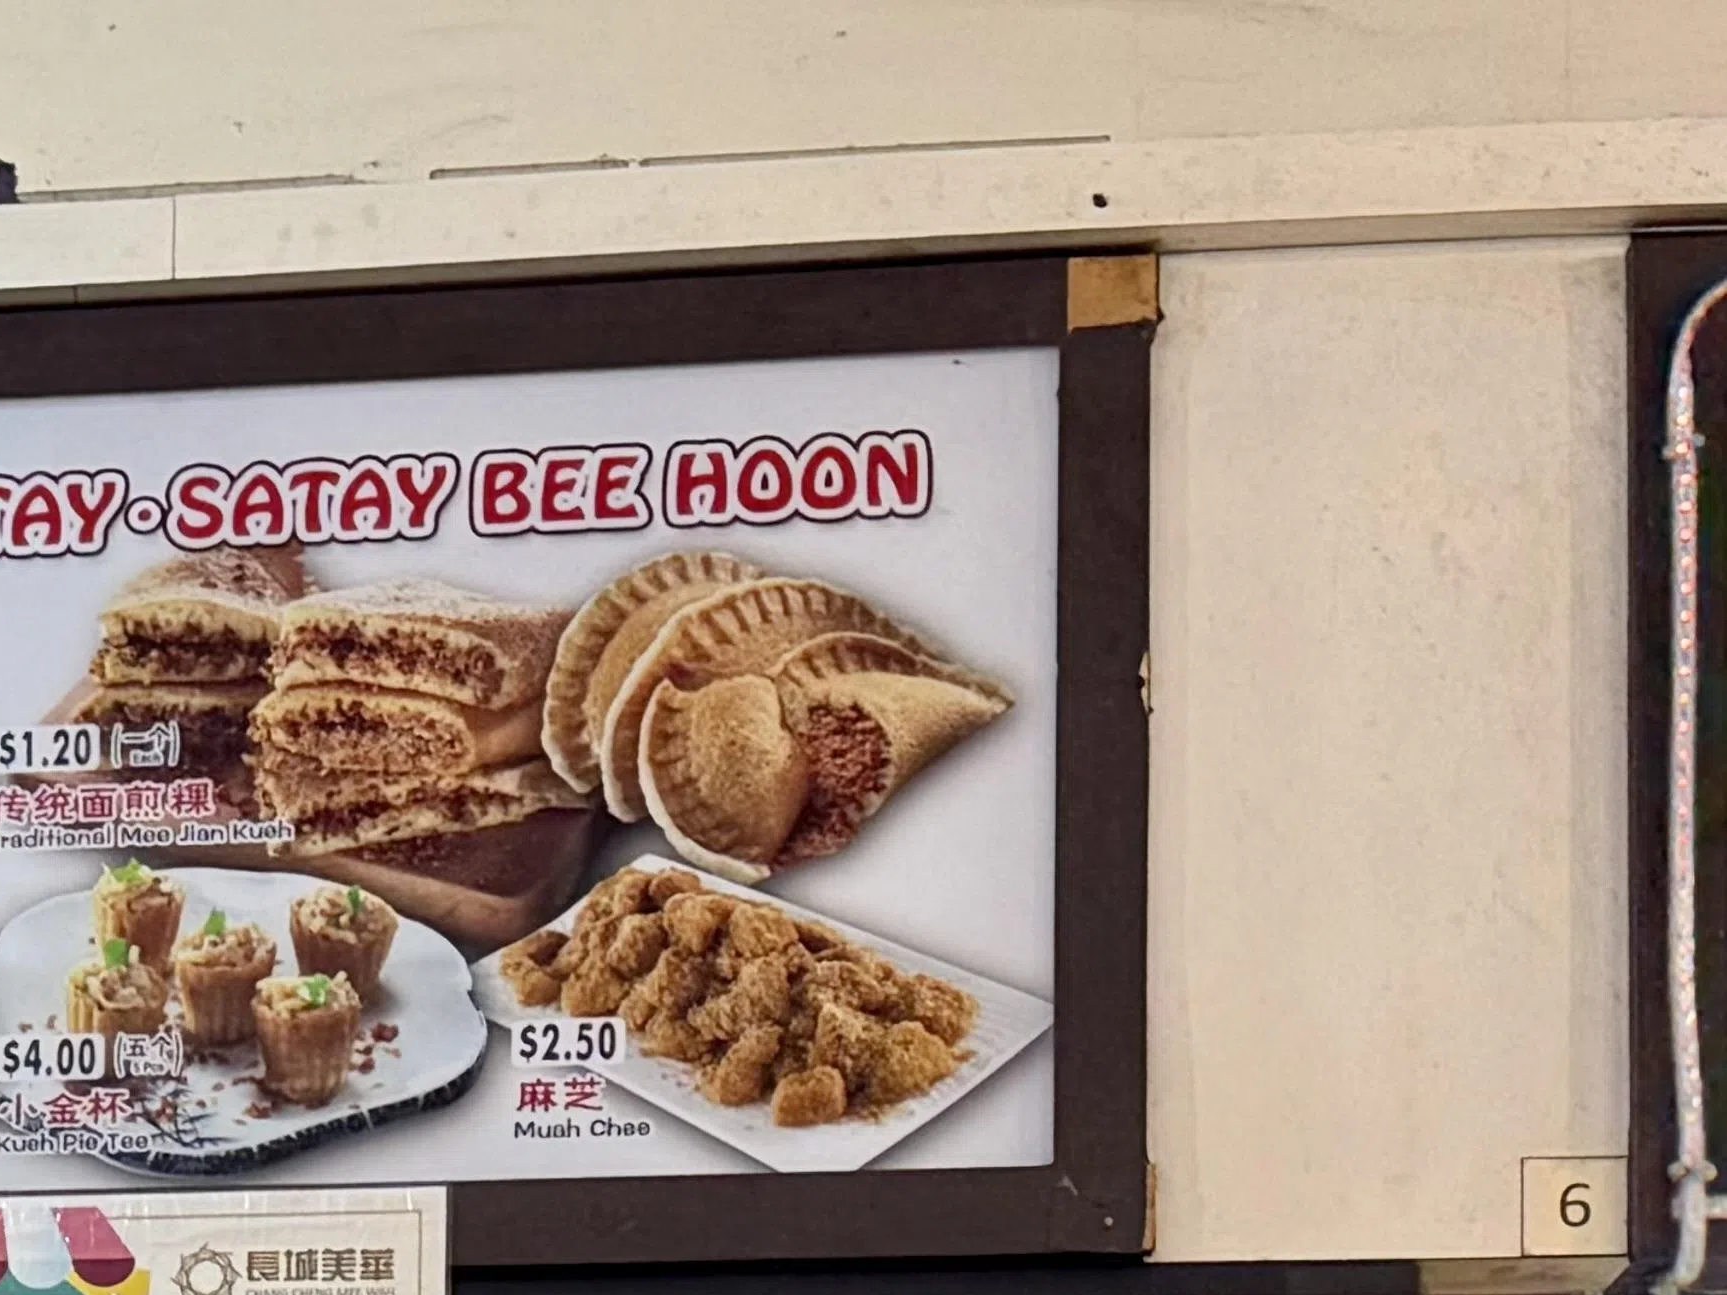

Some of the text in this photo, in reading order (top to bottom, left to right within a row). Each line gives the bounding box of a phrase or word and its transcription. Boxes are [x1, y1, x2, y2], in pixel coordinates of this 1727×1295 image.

[469, 441, 652, 537] BEE
[661, 429, 933, 529] HOON
[0, 729, 91, 768] $1.20
[121, 827, 170, 844] Mee
[180, 825, 224, 842] Jian
[233, 822, 293, 840] Kueh
[3, 1038, 95, 1078] $4.00
[519, 1021, 616, 1063] $2.50
[516, 1077, 603, 1113] 麻芝
[62, 1133, 99, 1150] Pie
[106, 1133, 147, 1149] Tee
[514, 1117, 650, 1139] Muah Chee
[1560, 1183, 1591, 1227] 6
